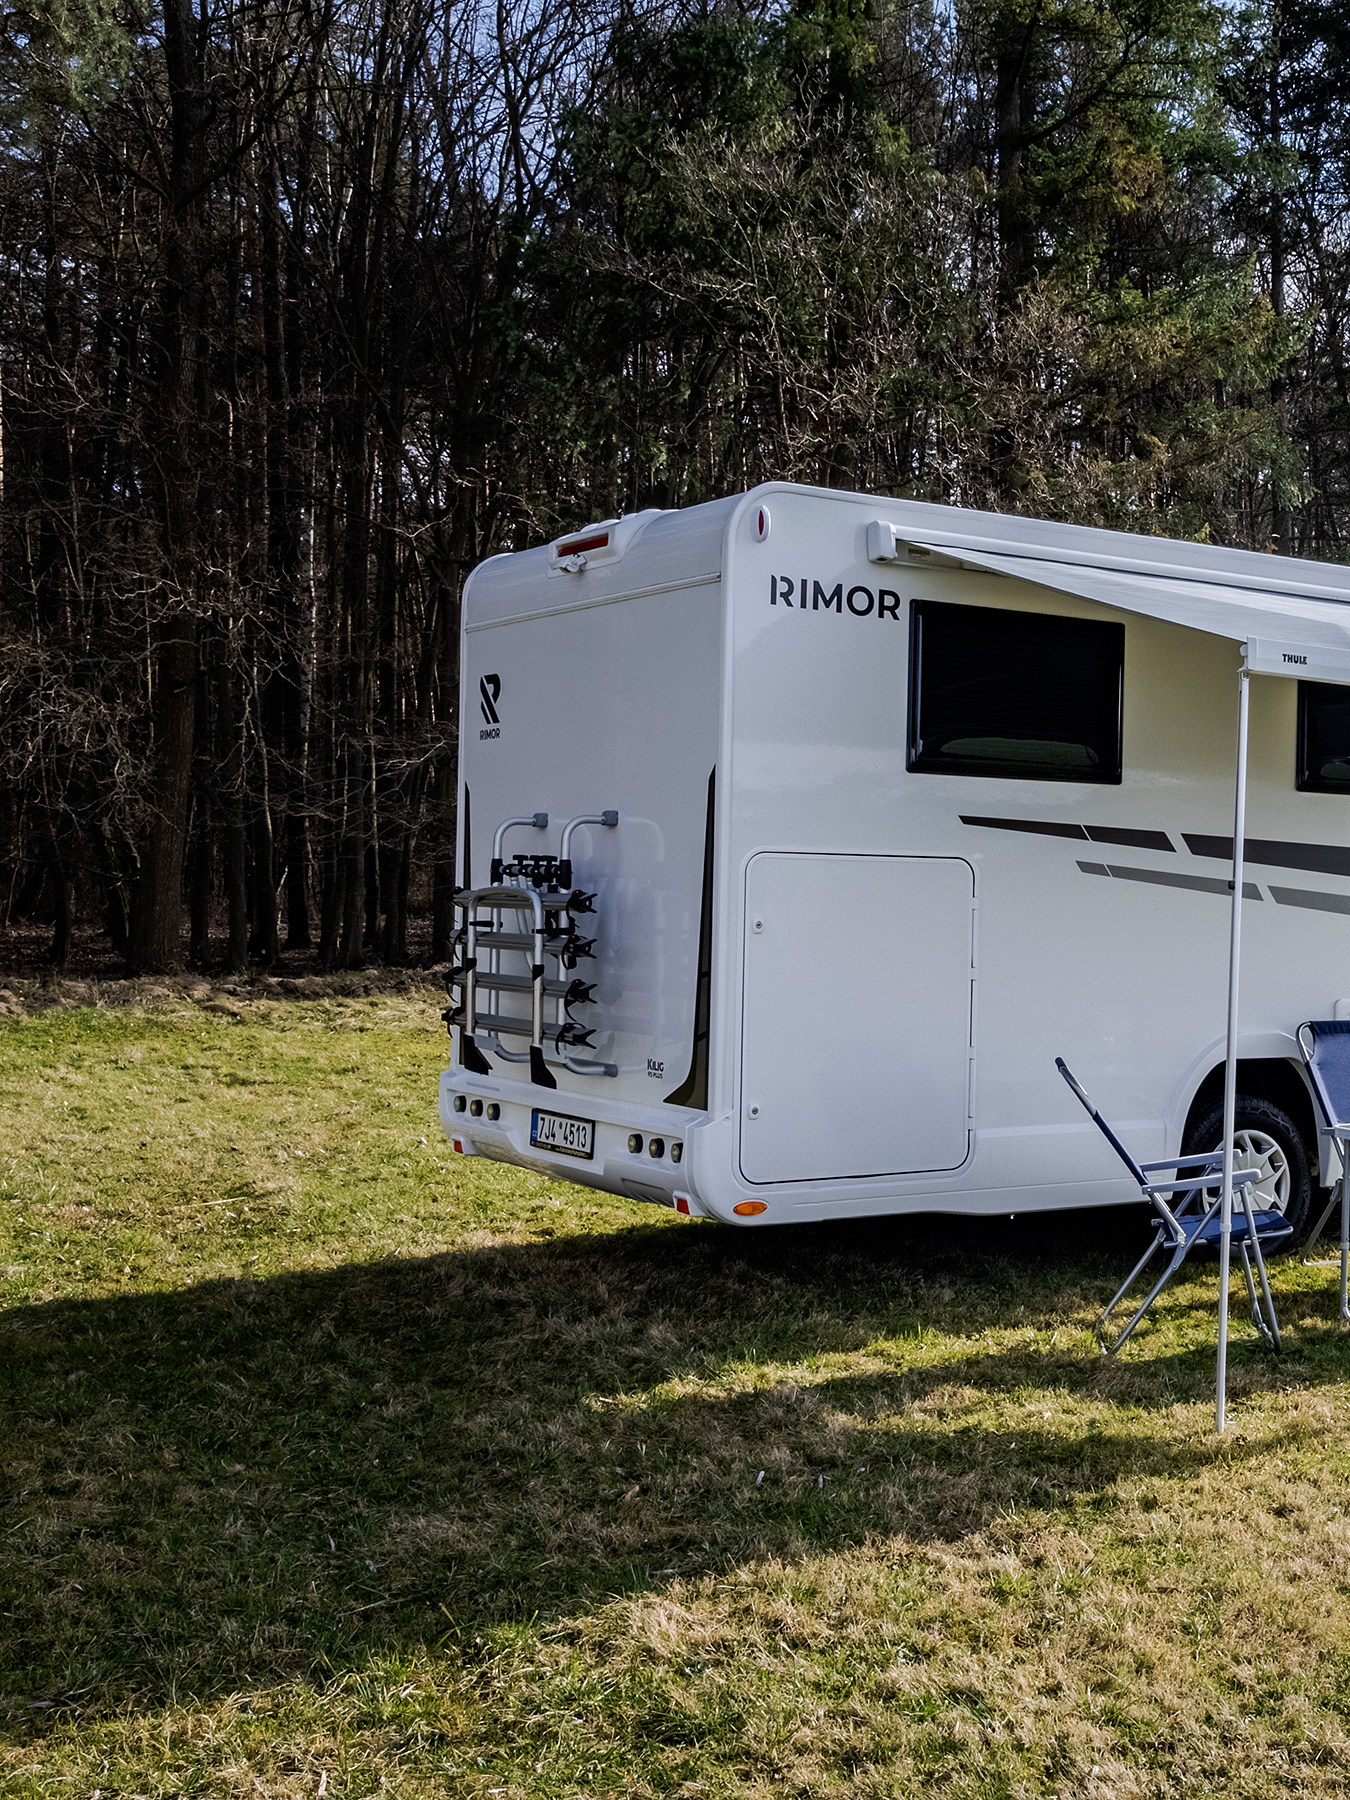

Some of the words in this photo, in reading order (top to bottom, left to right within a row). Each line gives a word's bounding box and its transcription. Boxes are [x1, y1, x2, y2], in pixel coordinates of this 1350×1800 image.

[770, 574, 901, 621] RIMOR
[1282, 653, 1308, 665] THULE
[479, 727, 501, 741] RIMOR
[539, 1116, 556, 1142] 7J4
[563, 1121, 587, 1149] 4513
